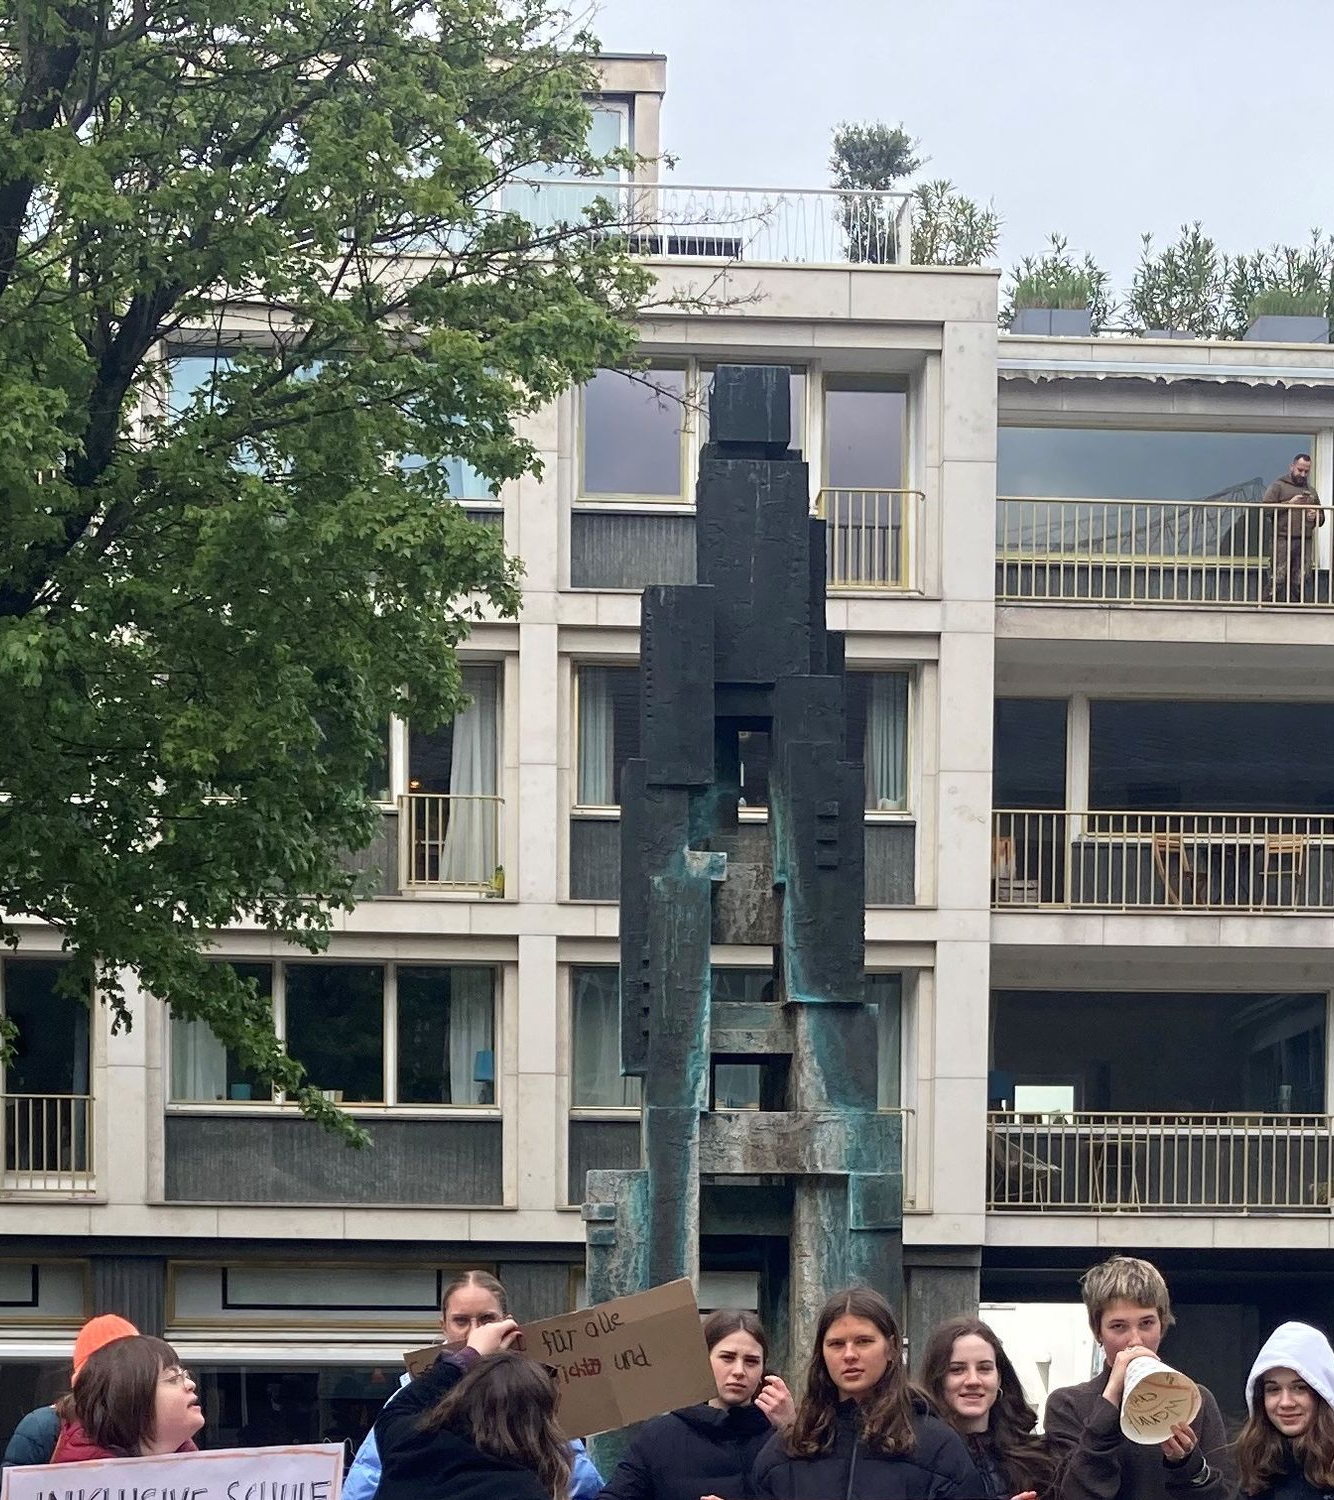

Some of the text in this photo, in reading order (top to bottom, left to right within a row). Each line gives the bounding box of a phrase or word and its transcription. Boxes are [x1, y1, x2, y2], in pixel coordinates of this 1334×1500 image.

[541, 1311, 625, 1356] für alle
[613, 1343, 652, 1370] und
